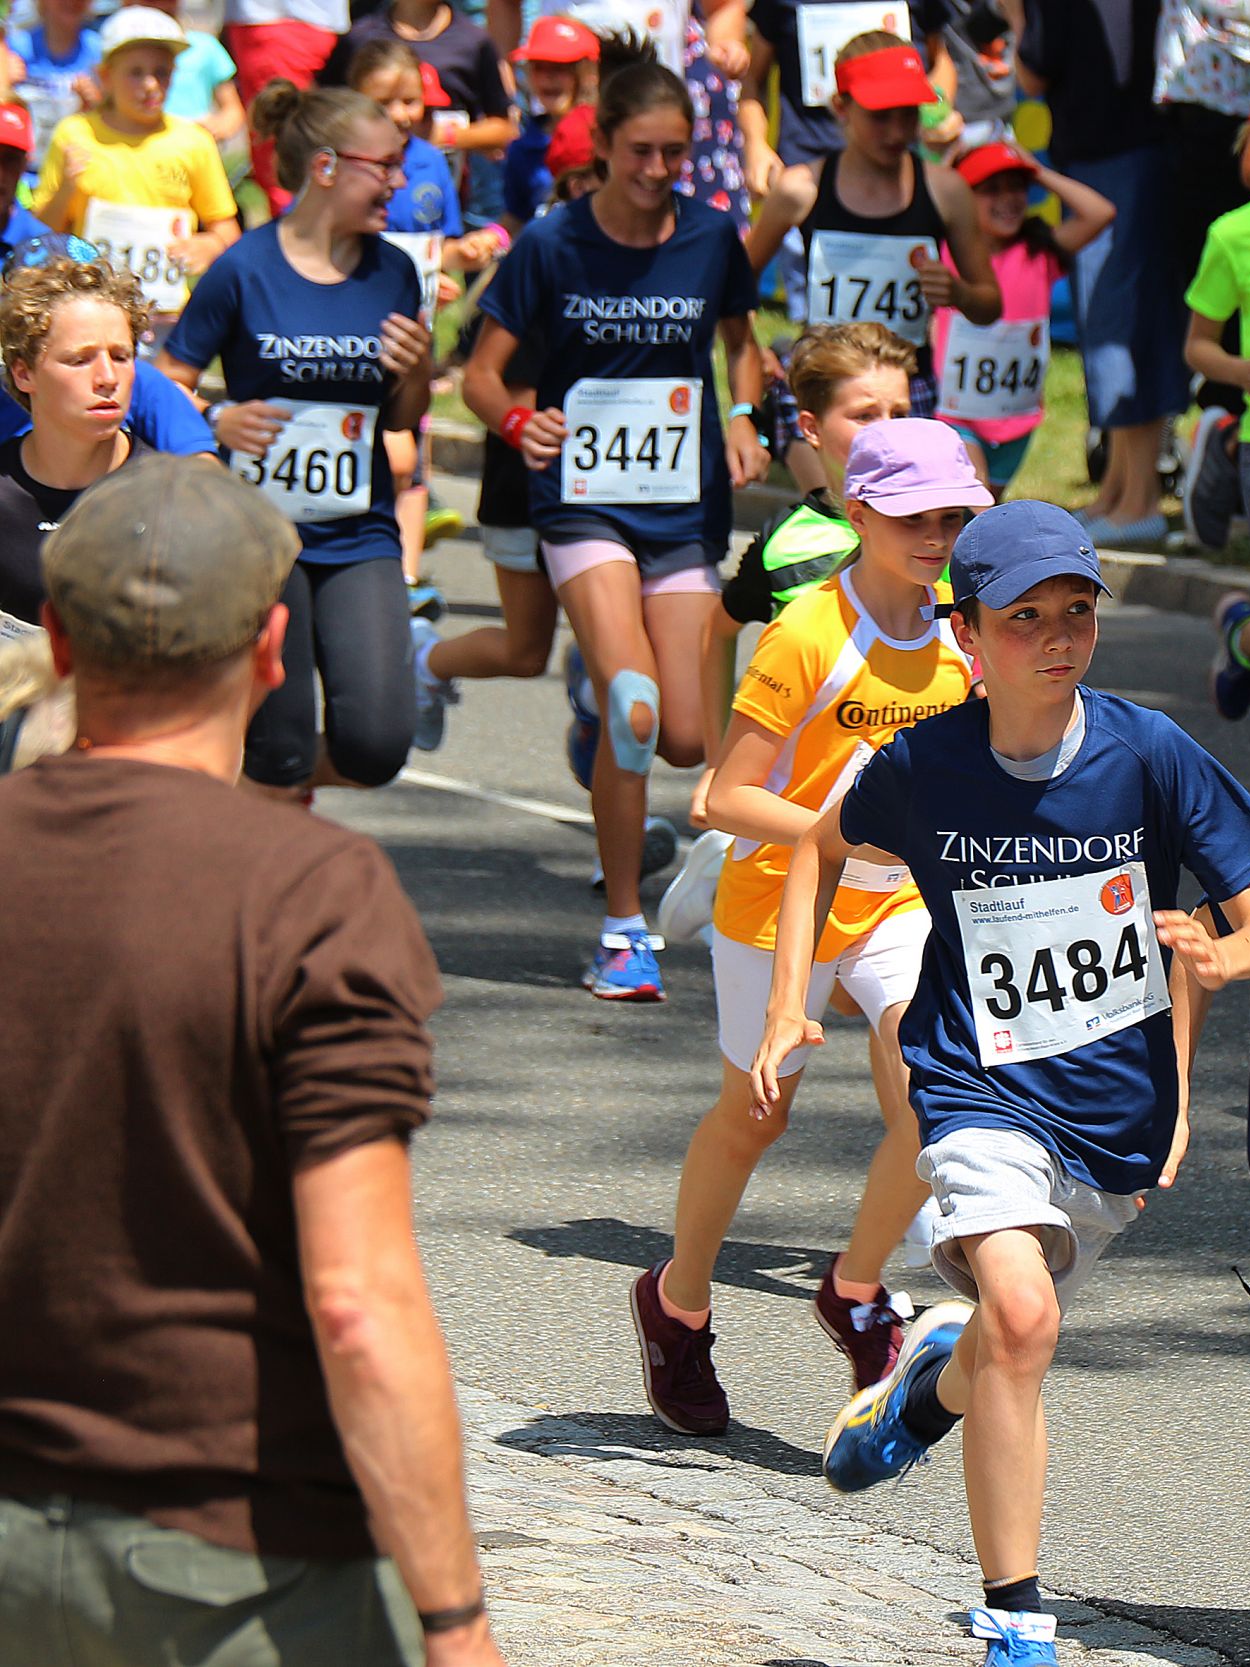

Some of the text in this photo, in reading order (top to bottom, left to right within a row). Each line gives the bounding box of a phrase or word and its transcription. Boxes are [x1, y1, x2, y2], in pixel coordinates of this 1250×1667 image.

[820, 273, 924, 321] 1743
[256, 332, 384, 359] ZINZENDO
[582, 320, 692, 345] SCHULEN
[953, 355, 1041, 395] 1844
[573, 425, 689, 472] 3447
[241, 448, 358, 496] 3460
[837, 697, 965, 729] Continent
[936, 827, 1145, 863] ZINZENDORF
[970, 897, 1025, 914] Stadtlauf
[972, 904, 1080, 924] www.laufend-mithelfen.de
[980, 922, 1148, 1020] 3484
